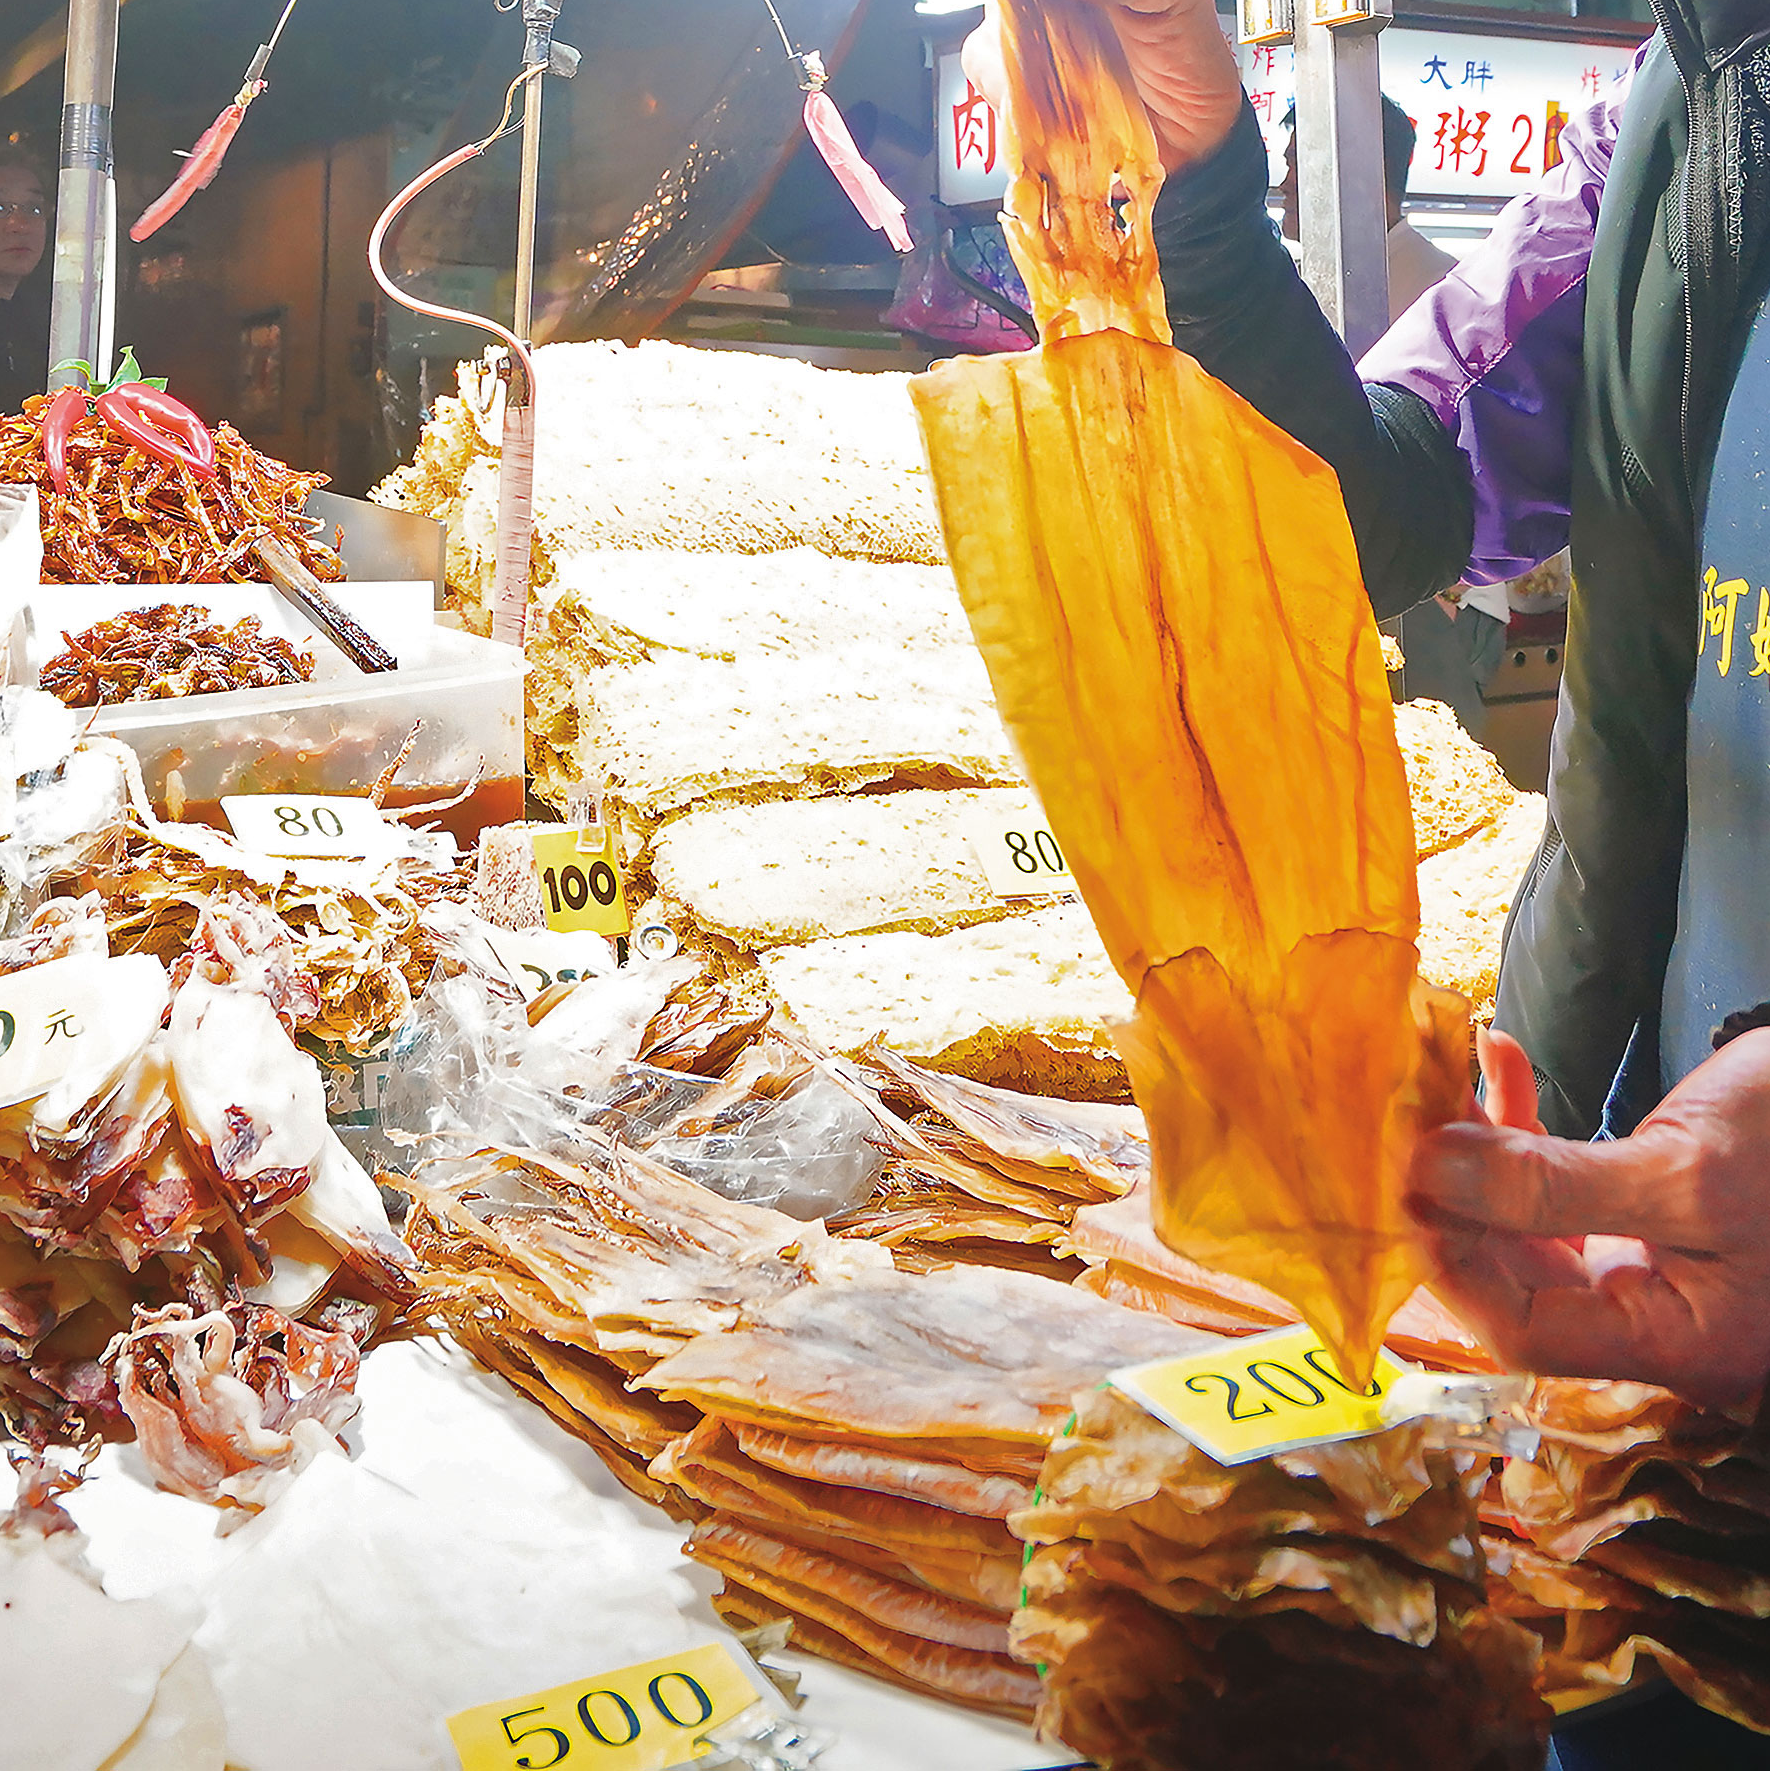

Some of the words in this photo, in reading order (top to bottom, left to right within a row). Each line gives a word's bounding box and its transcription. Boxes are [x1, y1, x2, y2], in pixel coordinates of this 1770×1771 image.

[1419, 54, 1496, 94] 大胖
[273, 804, 344, 840] 80
[1004, 829, 1064, 875] 80
[542, 859, 618, 913] 100
[499, 1669, 717, 1771] 500
